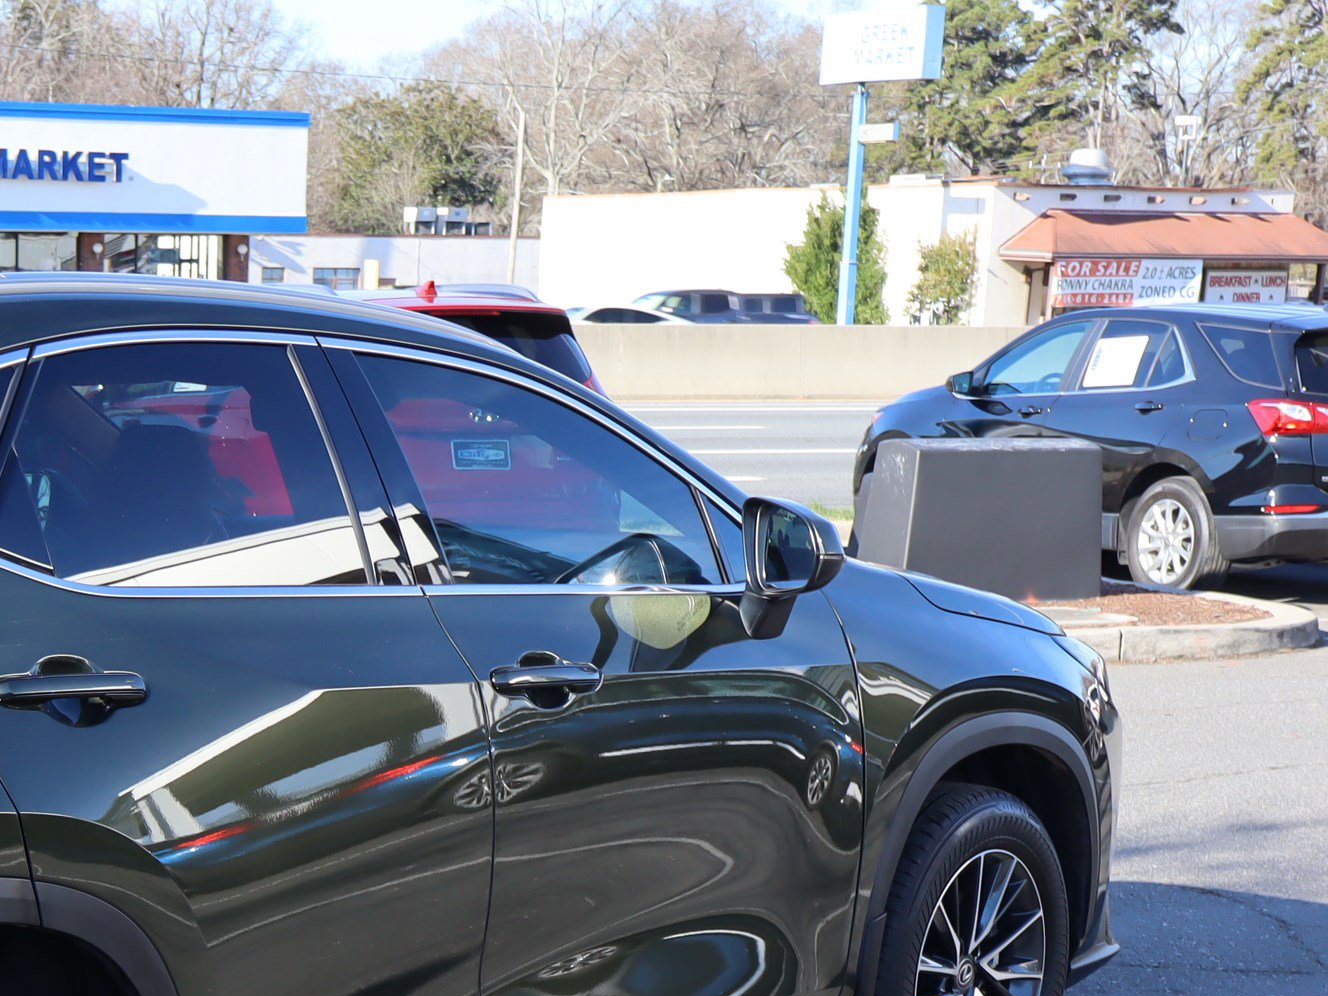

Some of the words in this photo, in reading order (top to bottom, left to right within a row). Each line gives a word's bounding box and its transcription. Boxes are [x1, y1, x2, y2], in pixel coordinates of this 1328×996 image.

[861, 23, 908, 43] GREEK
[853, 46, 915, 65] MARKET
[1057, 261, 1092, 276] FOR
[1096, 260, 1140, 276] SALE
[1143, 267, 1157, 279] 2.0
[1166, 266, 1196, 279] ACRES
[1092, 278, 1134, 291] CHAKRA
[1209, 276, 1252, 287] BREAKFAST
[1261, 276, 1287, 287] LUNCH
[1138, 286, 1175, 298] ZONED
[1180, 286, 1195, 298] CG
[1233, 292, 1261, 303] DINNER
